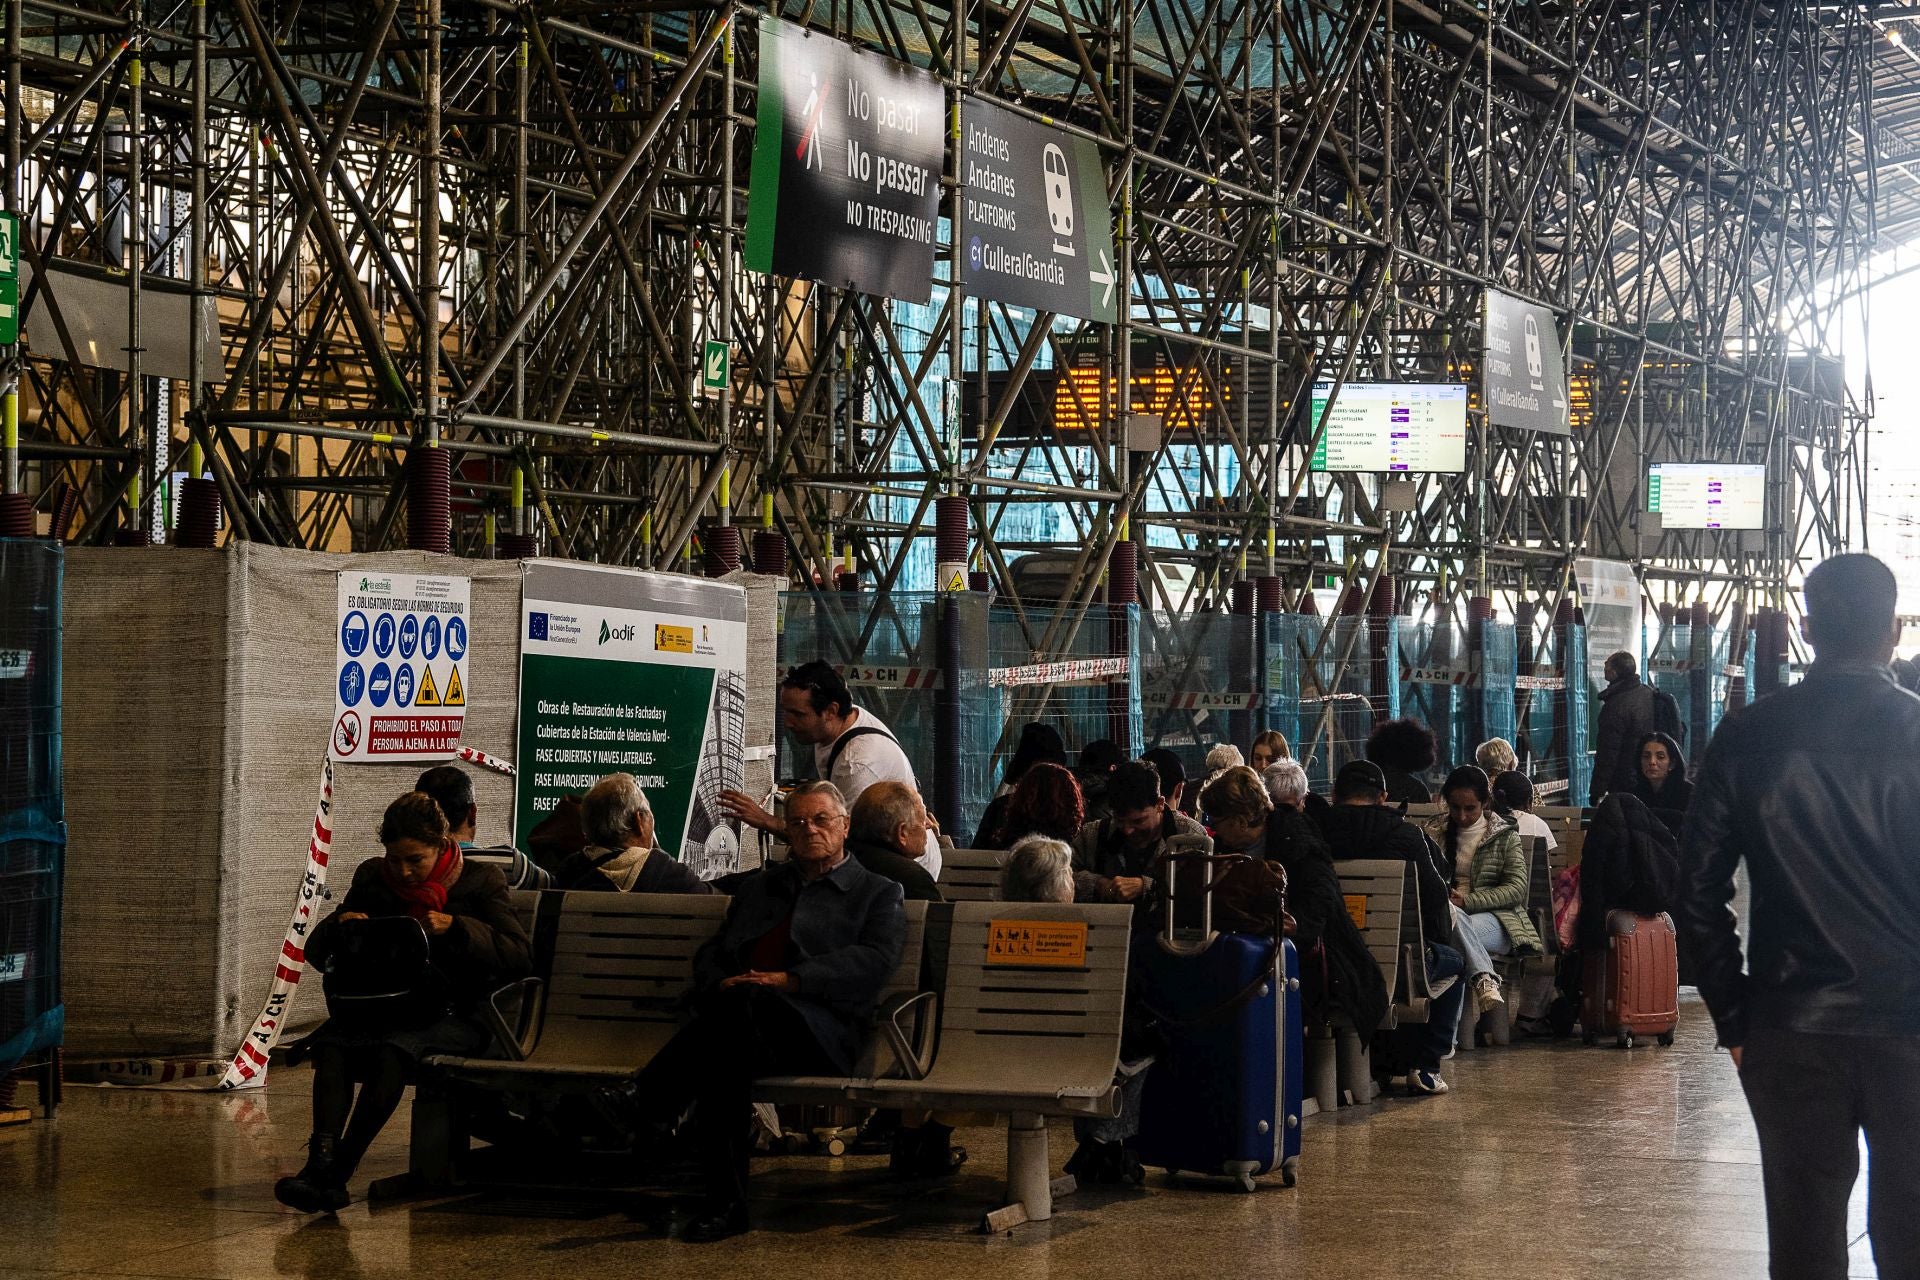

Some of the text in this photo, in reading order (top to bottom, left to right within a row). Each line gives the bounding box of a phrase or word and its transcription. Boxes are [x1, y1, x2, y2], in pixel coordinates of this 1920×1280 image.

[848, 78, 921, 136] No pasar
[968, 122, 1009, 162] Andenes
[847, 139, 928, 197] No passar
[968, 160, 1015, 198] Andanes
[847, 200, 931, 244] NO TRESPASSING
[968, 199, 1016, 232] PLATFORMS
[971, 243, 1065, 286] C1 Cullera/Gandia
[348, 596, 356, 608] ES
[356, 596, 391, 610] OBLIGATORIO
[408, 599, 417, 612] LAS
[434, 601, 440, 613] DE
[549, 613, 571, 623] Financiado
[611, 624, 636, 641] adif
[537, 700, 667, 723] Obras de Restauración de las Fachadas y
[373, 719, 409, 732] PROHIBIDO
[410, 720, 419, 732] EL
[420, 720, 440, 732] PASO
[441, 720, 447, 732] A
[536, 724, 571, 739] Cubiertas
[571, 725, 581, 739] de
[581, 726, 588, 740] la
[589, 726, 616, 741] Estación
[616, 727, 626, 741] de
[626, 728, 651, 742] Valencia
[652, 729, 667, 742] Nord
[372, 737, 404, 751] PERSONA
[405, 737, 428, 750] AJENA
[429, 737, 435, 750] A
[436, 737, 446, 750] LA
[536, 749, 553, 762] FASE
[554, 749, 592, 763] CUBIERTAS
[592, 751, 597, 763] Y
[598, 751, 620, 764] NAVES
[620, 752, 653, 765] LATERALES
[534, 773, 552, 787] FASE
[533, 797, 551, 811] FASE
